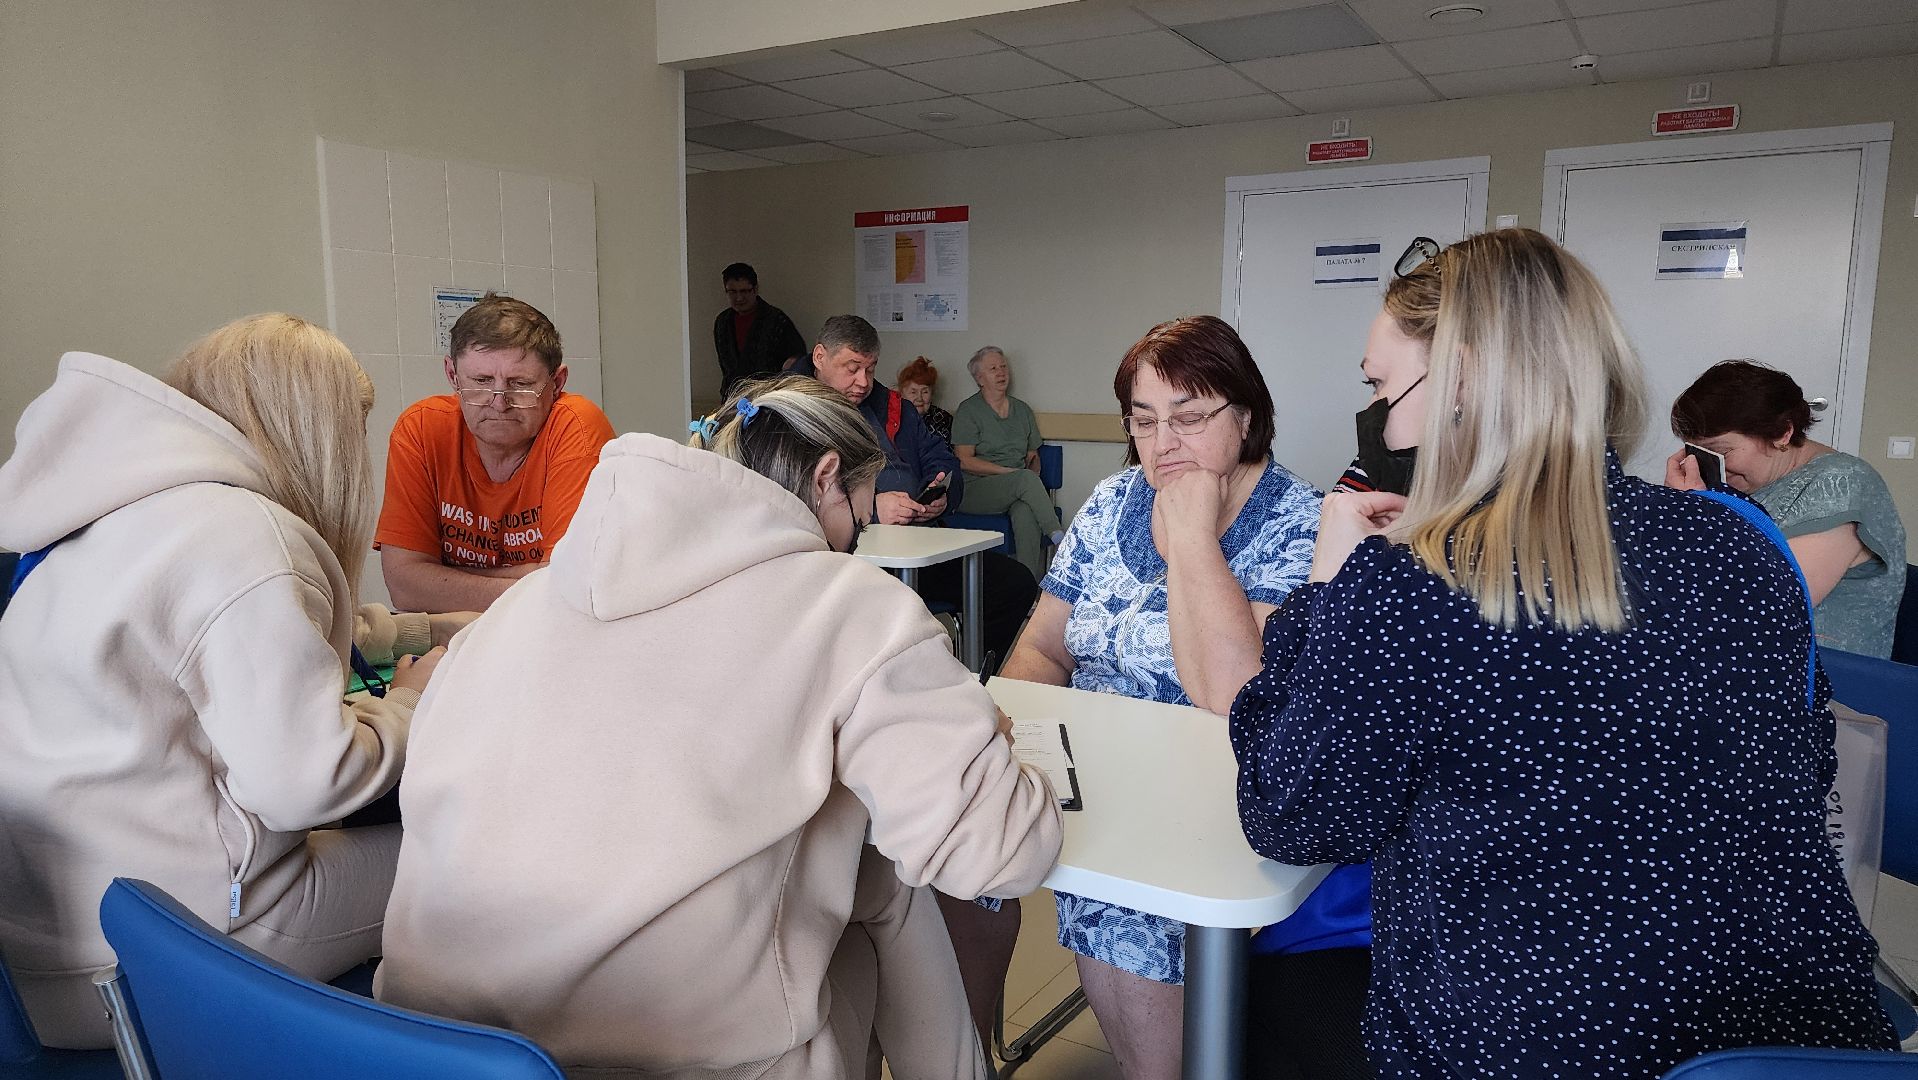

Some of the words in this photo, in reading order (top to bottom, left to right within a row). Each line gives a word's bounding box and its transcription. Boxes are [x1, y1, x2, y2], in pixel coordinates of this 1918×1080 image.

[884, 210, 936, 223] ИНФОРМАЦИЯ
[1326, 258, 1353, 266] ПАЛАТА
[441, 501, 474, 527] WAS
[456, 546, 487, 564] NOW
